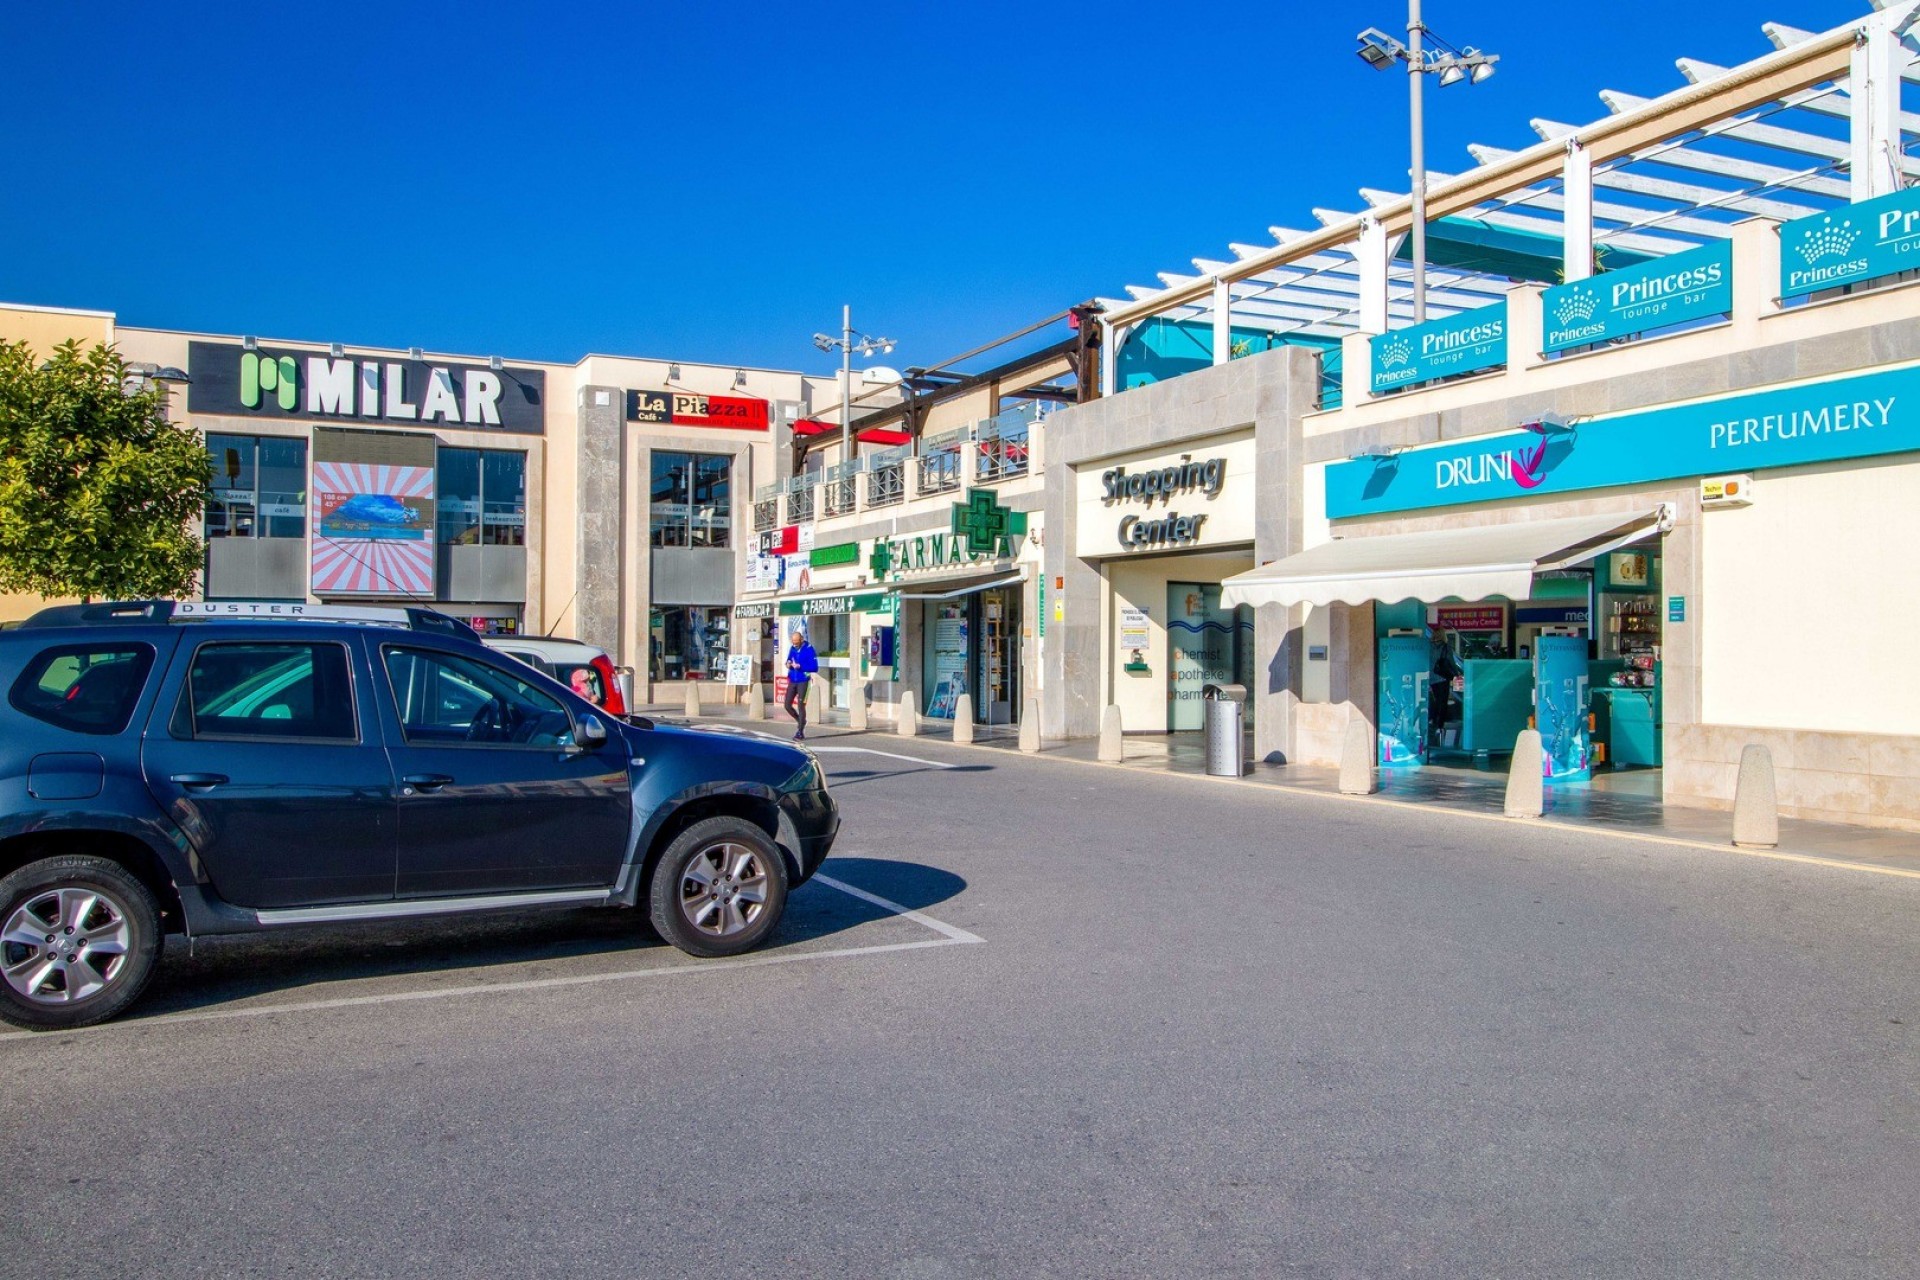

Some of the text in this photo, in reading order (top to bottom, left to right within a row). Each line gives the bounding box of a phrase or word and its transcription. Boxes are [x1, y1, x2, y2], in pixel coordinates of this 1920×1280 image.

[1790, 258, 1868, 287] Princess
[1612, 262, 1722, 307] Princess
[1623, 292, 1706, 319] lounge bar
[1422, 320, 1503, 354] Princess
[1550, 321, 1605, 344] Princess
[1430, 344, 1492, 366] lounge bar
[1376, 367, 1417, 385] Princess
[307, 357, 501, 425] MILAR
[638, 393, 667, 412] La
[675, 397, 748, 417] Piazza
[638, 412, 657, 421] Café
[1710, 397, 1896, 449] PERFUMERY
[1101, 454, 1228, 505] Shopping
[1436, 450, 1512, 488] DRUNI
[1118, 511, 1209, 547] Center
[762, 536, 770, 548] La
[888, 533, 1012, 570] FARMAA
[182, 604, 304, 614] DUSTER
[740, 605, 766, 618] FARMACIA
[810, 599, 846, 614] FARMACIA
[1460, 618, 1479, 627] Beauty
[1480, 618, 1500, 626] Center
[1175, 648, 1221, 660] chemist
[1170, 667, 1224, 682] apotheke
